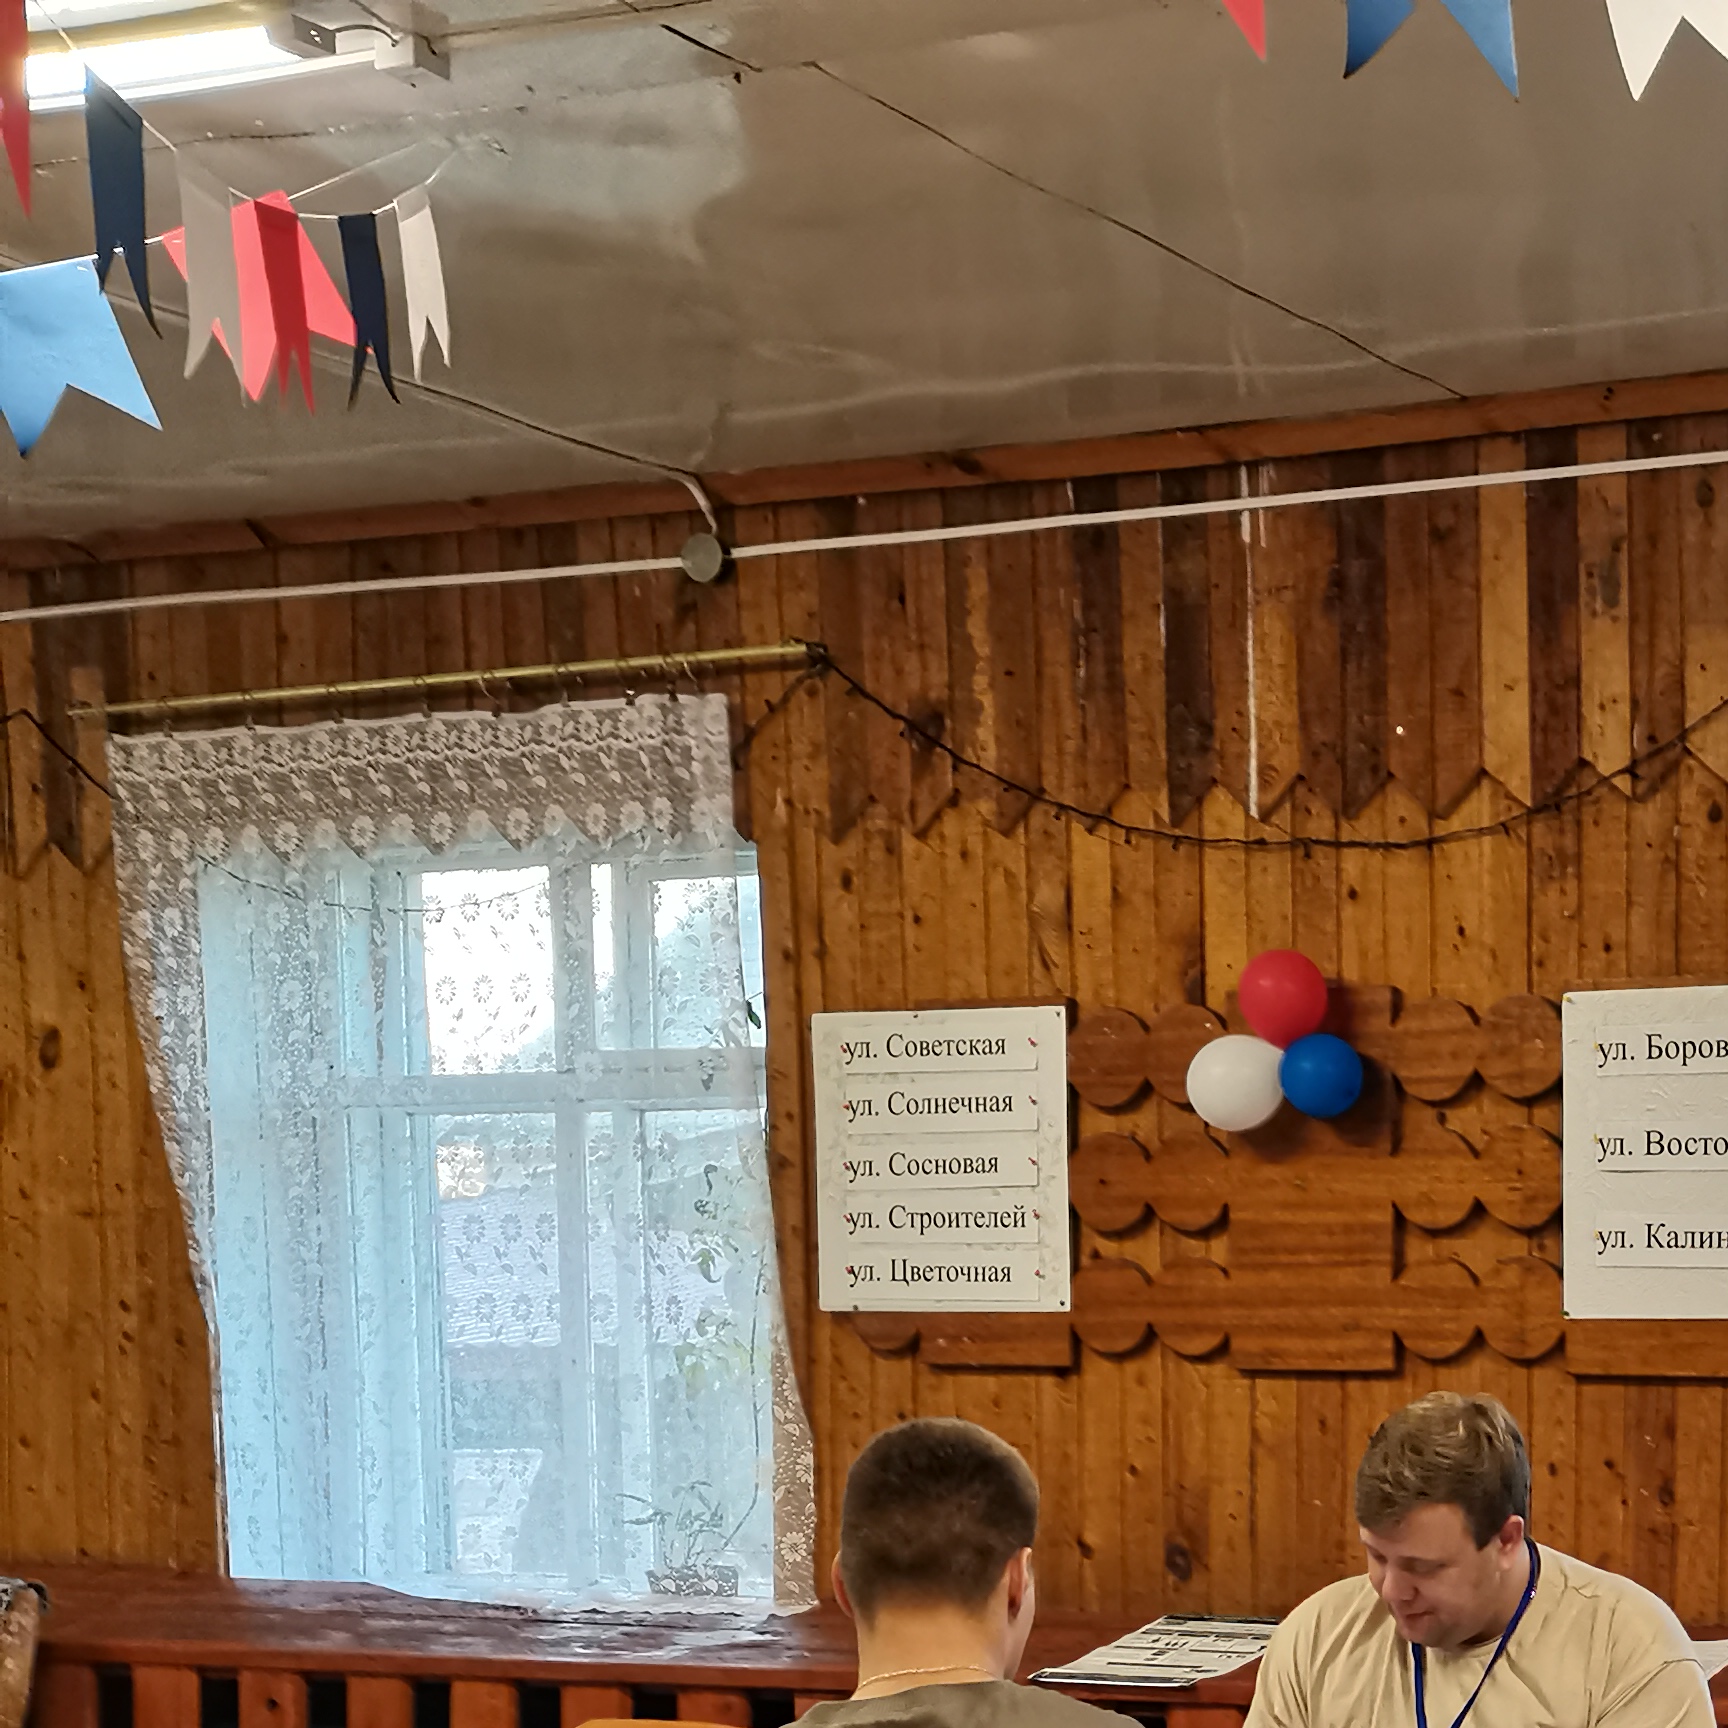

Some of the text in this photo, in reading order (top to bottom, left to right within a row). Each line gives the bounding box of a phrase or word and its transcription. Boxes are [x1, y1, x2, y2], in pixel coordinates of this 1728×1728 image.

[845, 1033, 1006, 1065] ул. Советская
[1598, 1042, 1635, 1068] ул.
[849, 1091, 1013, 1123] ул. Солнечная
[1598, 1137, 1633, 1163] ул.
[849, 1152, 998, 1183] ул. Сосновая
[849, 1204, 1026, 1236] ул. Строителей
[1598, 1230, 1634, 1255] ул.
[850, 1258, 1012, 1288] ул. Цветочная
